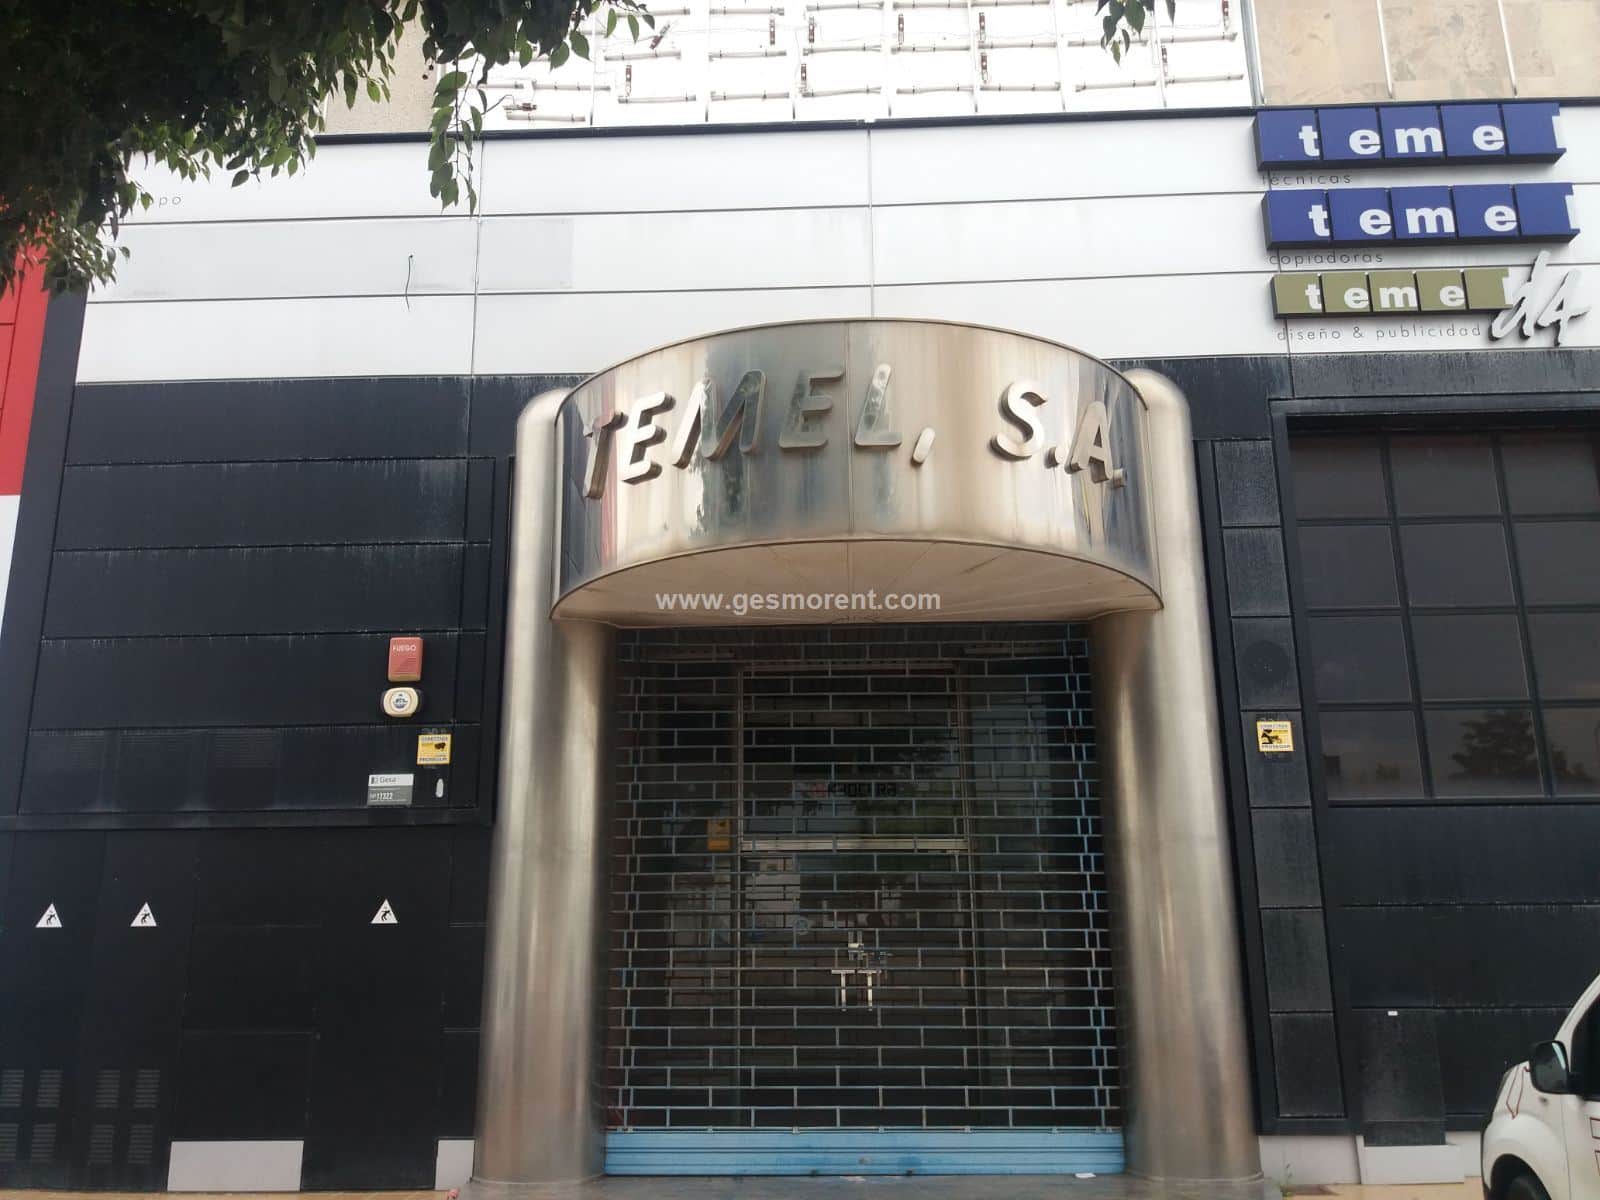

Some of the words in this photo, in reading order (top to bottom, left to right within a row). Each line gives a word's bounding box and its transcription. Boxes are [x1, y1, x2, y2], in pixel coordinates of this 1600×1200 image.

[1268, 250, 1384, 268] copiadoras
[1276, 325, 1342, 342] diseño
[1352, 325, 1364, 339] &
[1376, 323, 1482, 341] publicidad
[990, 379, 1128, 489] S.A.
